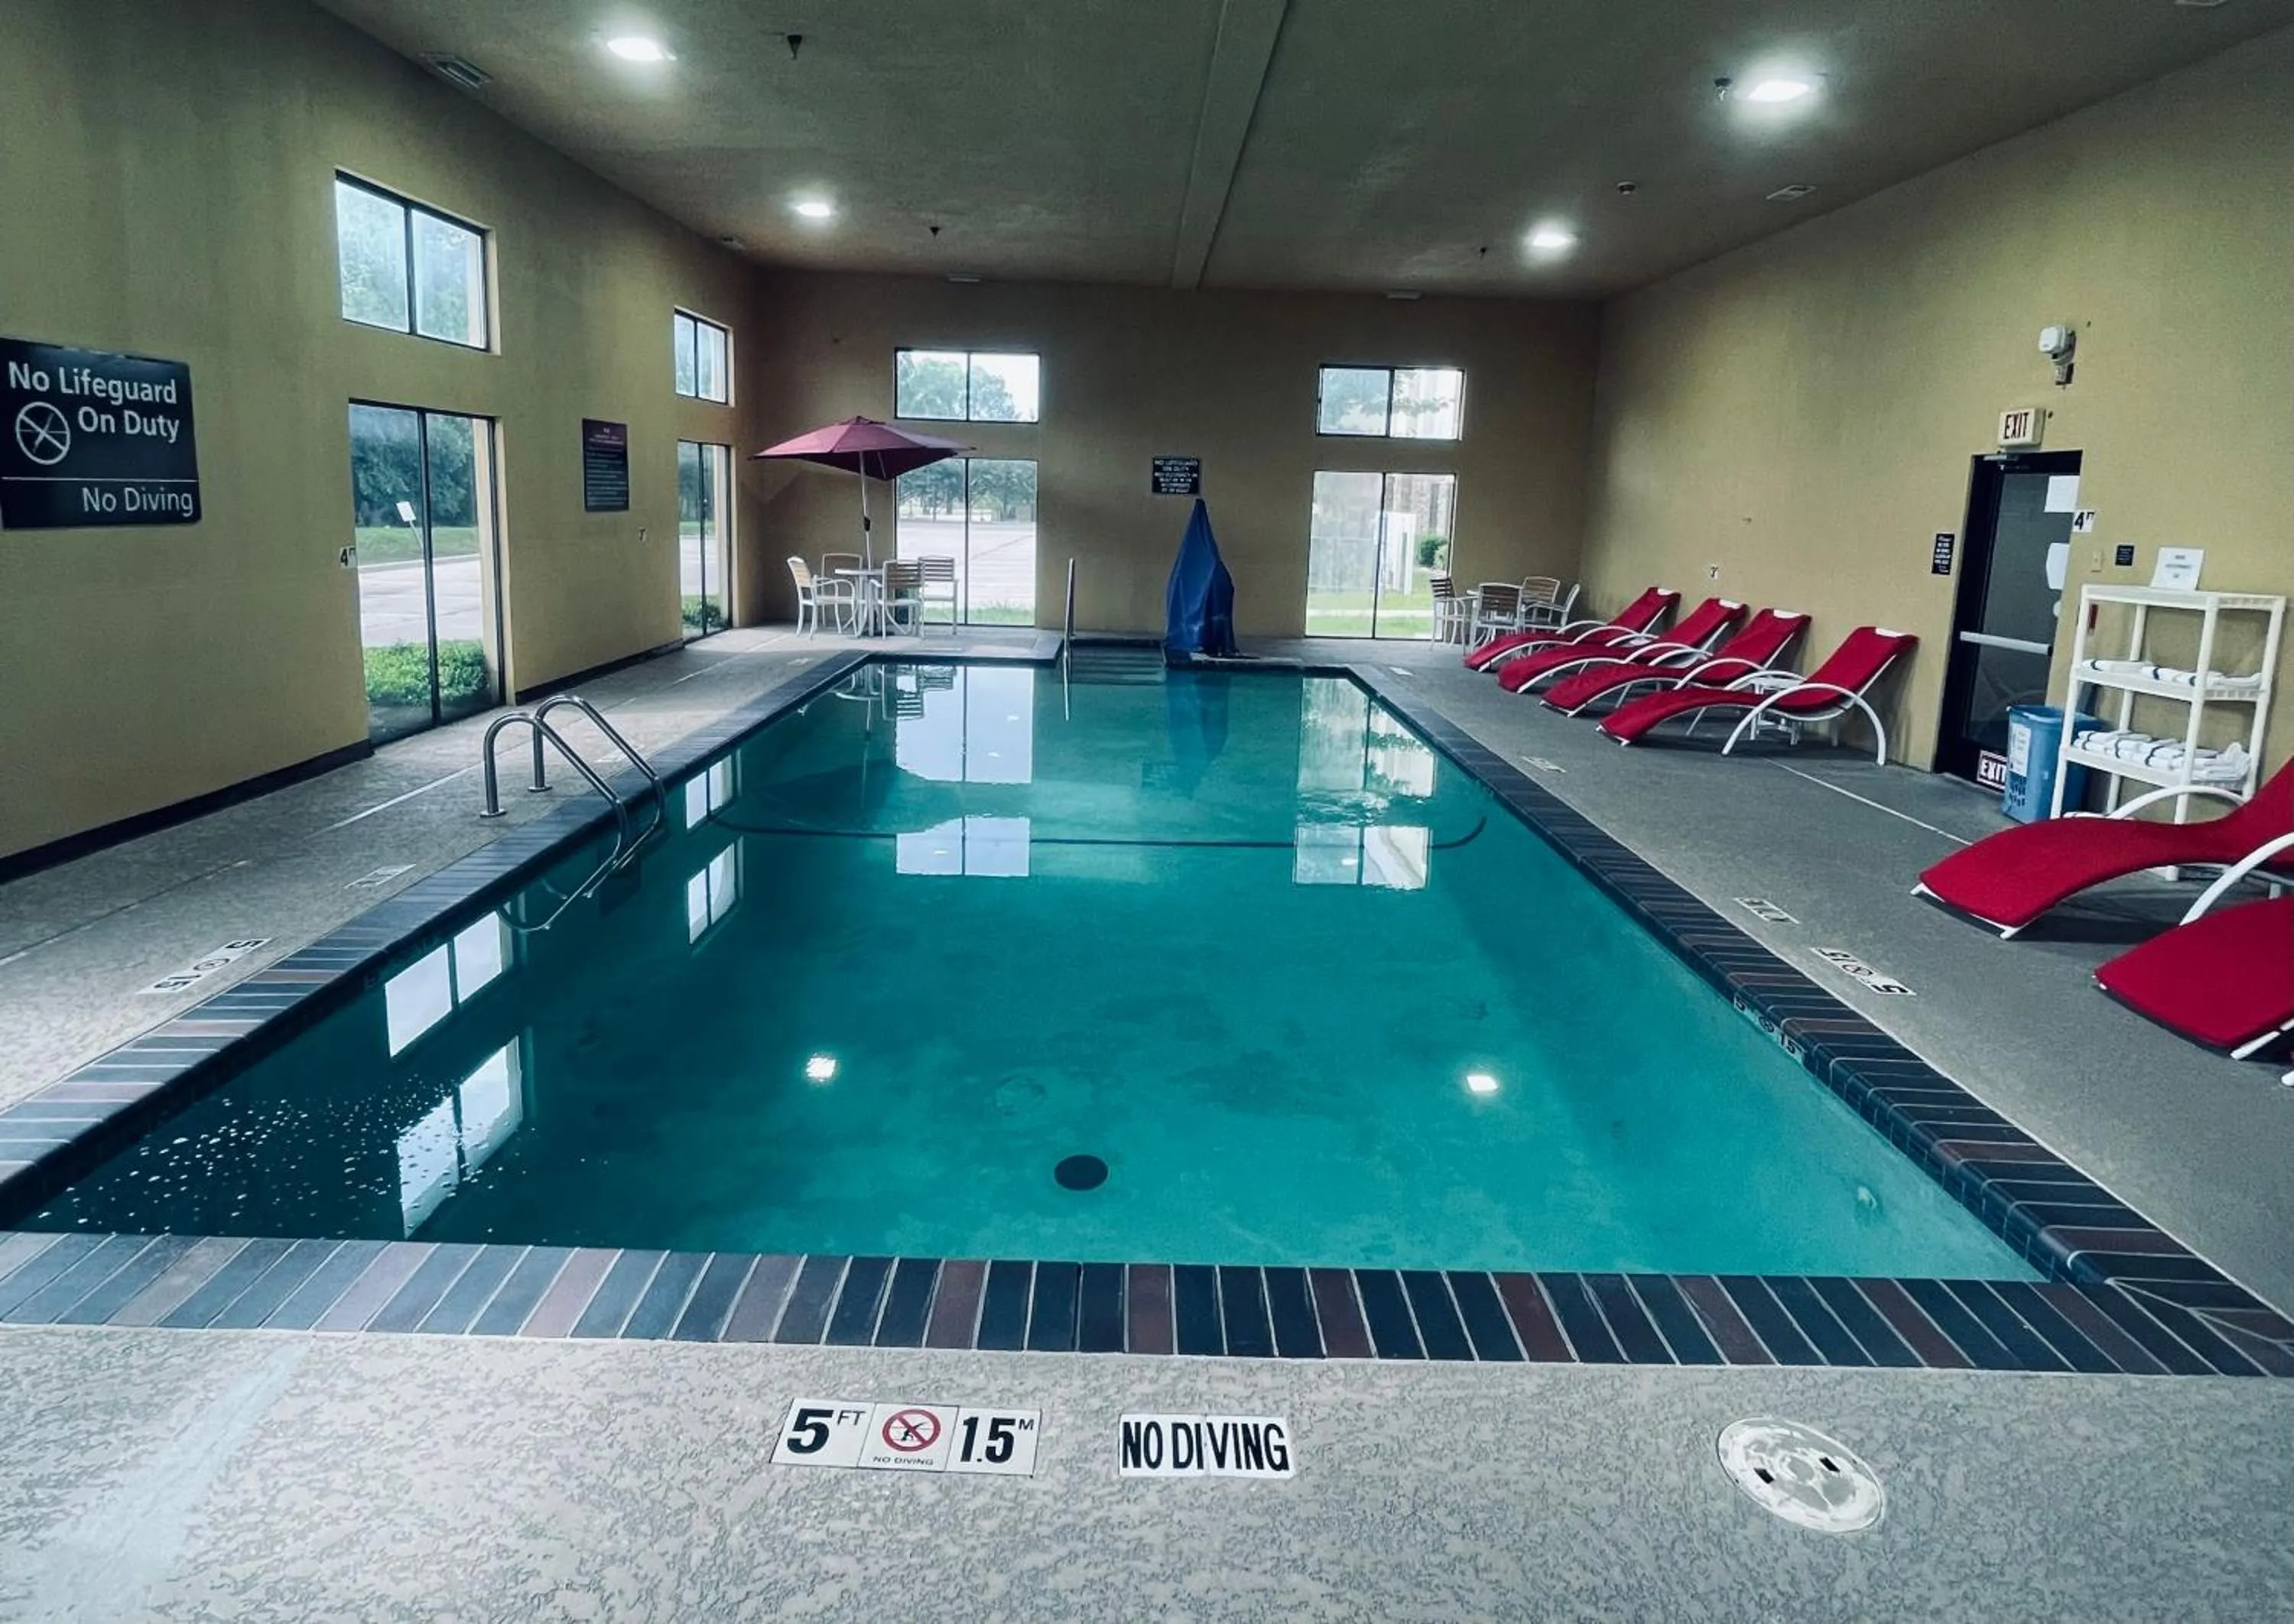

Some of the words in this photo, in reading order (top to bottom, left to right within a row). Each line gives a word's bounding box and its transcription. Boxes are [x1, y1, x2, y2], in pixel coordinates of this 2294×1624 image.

[9, 362, 50, 391] No
[59, 366, 177, 405] Lifeguard
[78, 407, 115, 434] On
[123, 410, 180, 443] Duty
[2004, 412, 2029, 440] EXIT
[82, 487, 117, 512] No
[124, 487, 193, 518] Diving
[1980, 758, 2006, 783] EXIT
[787, 1408, 834, 1454] 5
[837, 1410, 866, 1426] FT
[960, 1417, 1016, 1464] 1.5
[1018, 1418, 1035, 1431] M
[1122, 1421, 1164, 1470] NO
[1171, 1421, 1290, 1472] DIVING
[894, 1457, 934, 1466] DIVING
